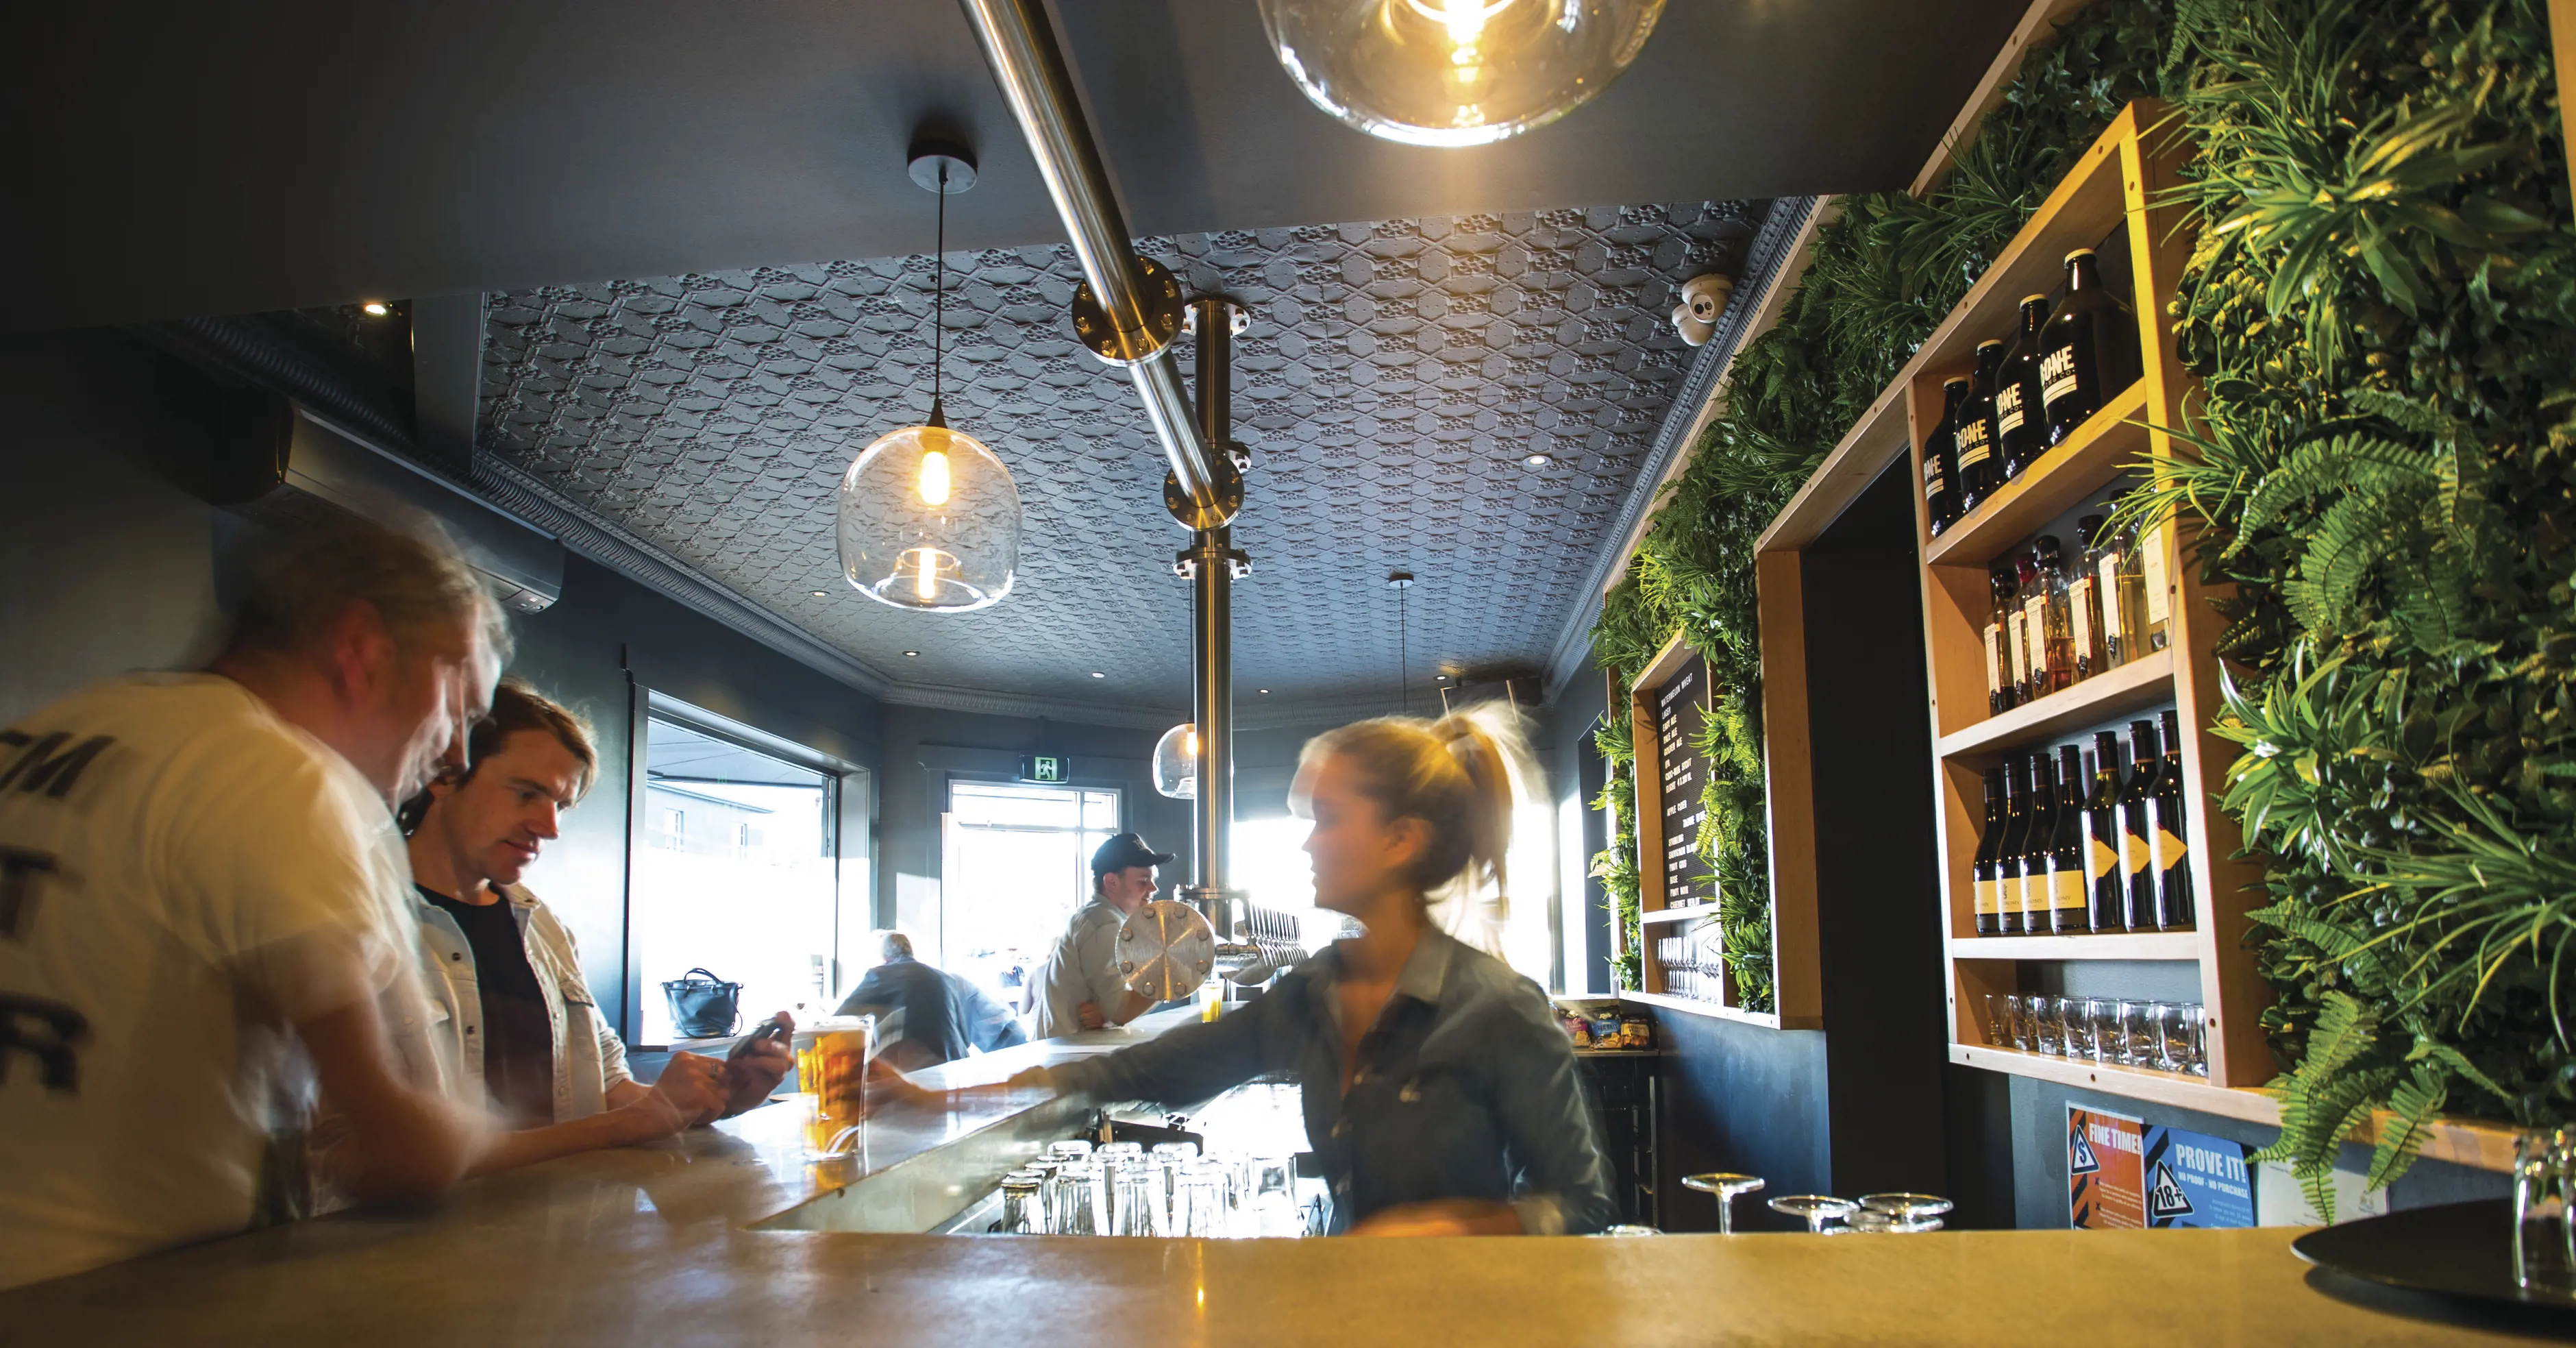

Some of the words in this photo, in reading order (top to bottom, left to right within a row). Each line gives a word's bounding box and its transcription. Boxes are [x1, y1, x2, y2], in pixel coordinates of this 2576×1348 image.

[1996, 382, 2022, 415] ONE
[1681, 672, 1693, 689] WHEAT
[1661, 706, 1671, 720] LAGER
[2088, 1122, 2111, 1147] FINE
[2111, 1128, 2142, 1155] TIME!
[2175, 1142, 2225, 1177] PROVE
[2225, 1155, 2246, 1184] IT!
[2155, 1185, 2183, 1208] 18+
[2177, 1171, 2186, 1181] NO
[2186, 1173, 2205, 1186] PROOF
[2208, 1178, 2217, 1190] NO
[2217, 1182, 2249, 1199] PURCHASE
